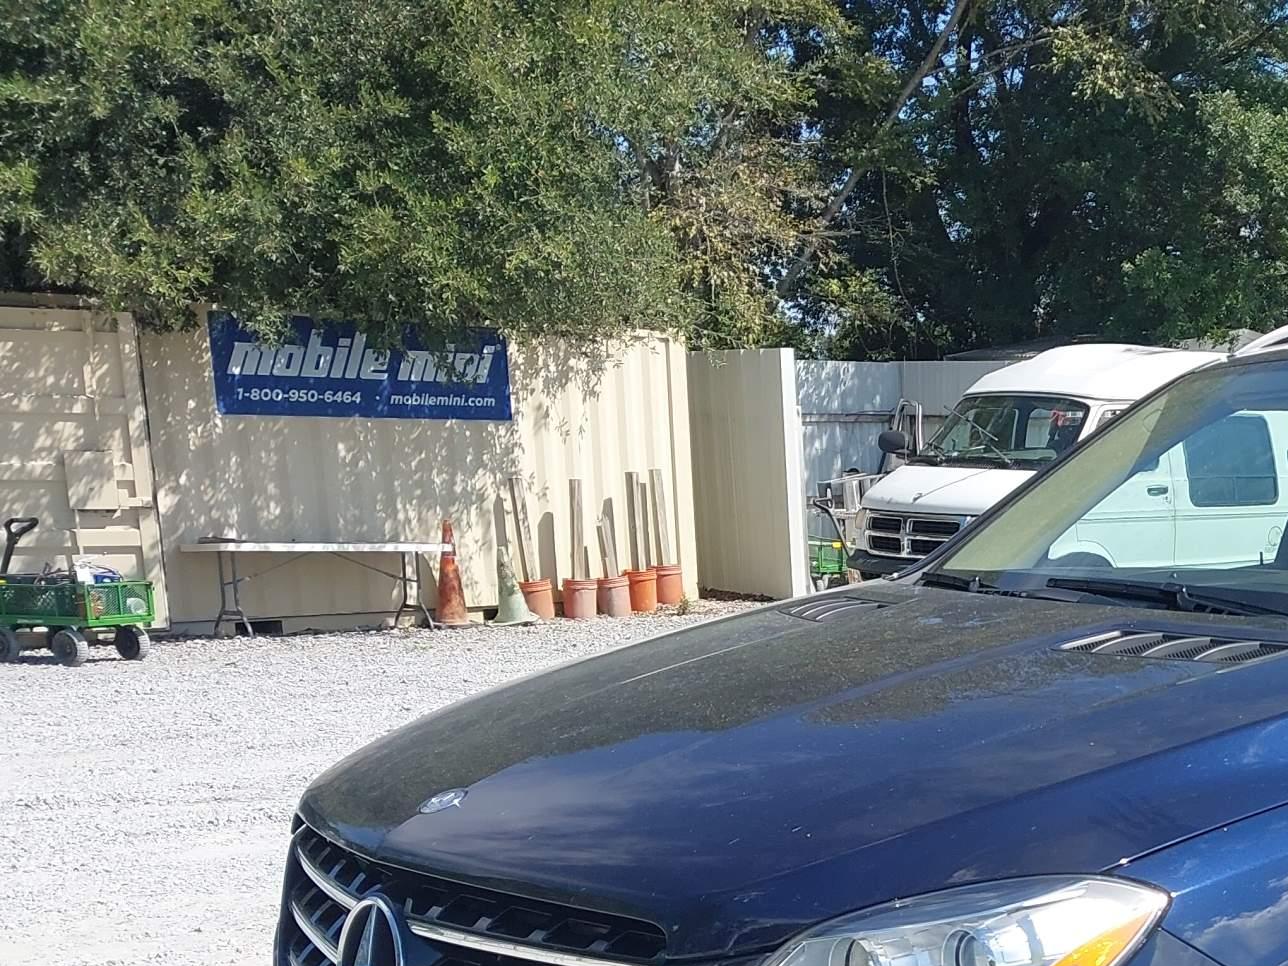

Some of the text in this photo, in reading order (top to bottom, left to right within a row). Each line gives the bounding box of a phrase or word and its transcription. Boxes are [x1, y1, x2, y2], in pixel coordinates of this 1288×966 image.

[226, 329, 495, 384] mobile mini
[237, 387, 496, 407] 1-800-950-6464 mobilemini.com
